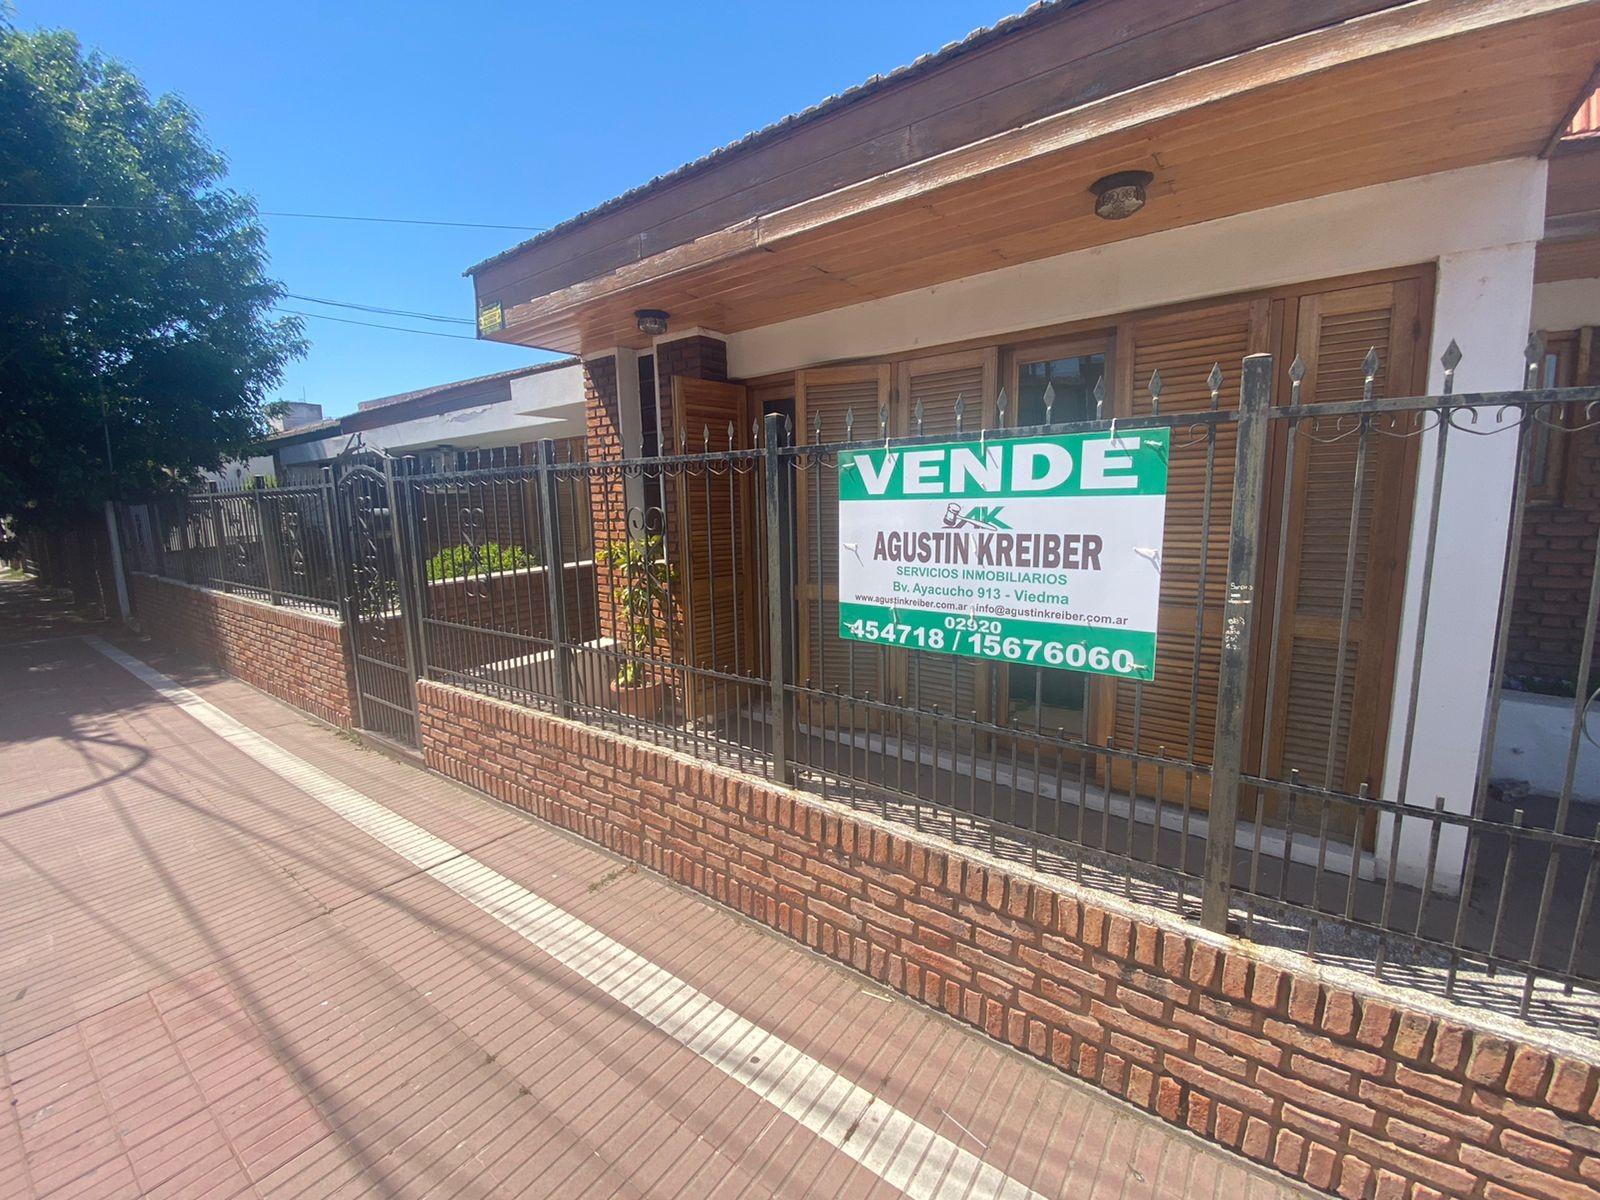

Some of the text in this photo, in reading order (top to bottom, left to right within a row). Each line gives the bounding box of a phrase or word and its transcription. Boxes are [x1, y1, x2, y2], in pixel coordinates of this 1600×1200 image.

[854, 437, 1140, 495] VENDE
[874, 531, 1103, 571] AGUSTIN KREIBER
[896, 566, 1067, 585] SERVICIOS INMOBILIARIOS
[855, 593, 1128, 625] www.agustinkreiber.com.ar info@agustinkreiber.com.ar
[893, 581, 910, 593] Bv.
[913, 583, 974, 597] Ayacucho
[978, 588, 1001, 600] 913
[1014, 590, 1069, 605] Viedma
[944, 617, 1002, 634] 02920
[850, 619, 1134, 673] 454718 / 15676060
